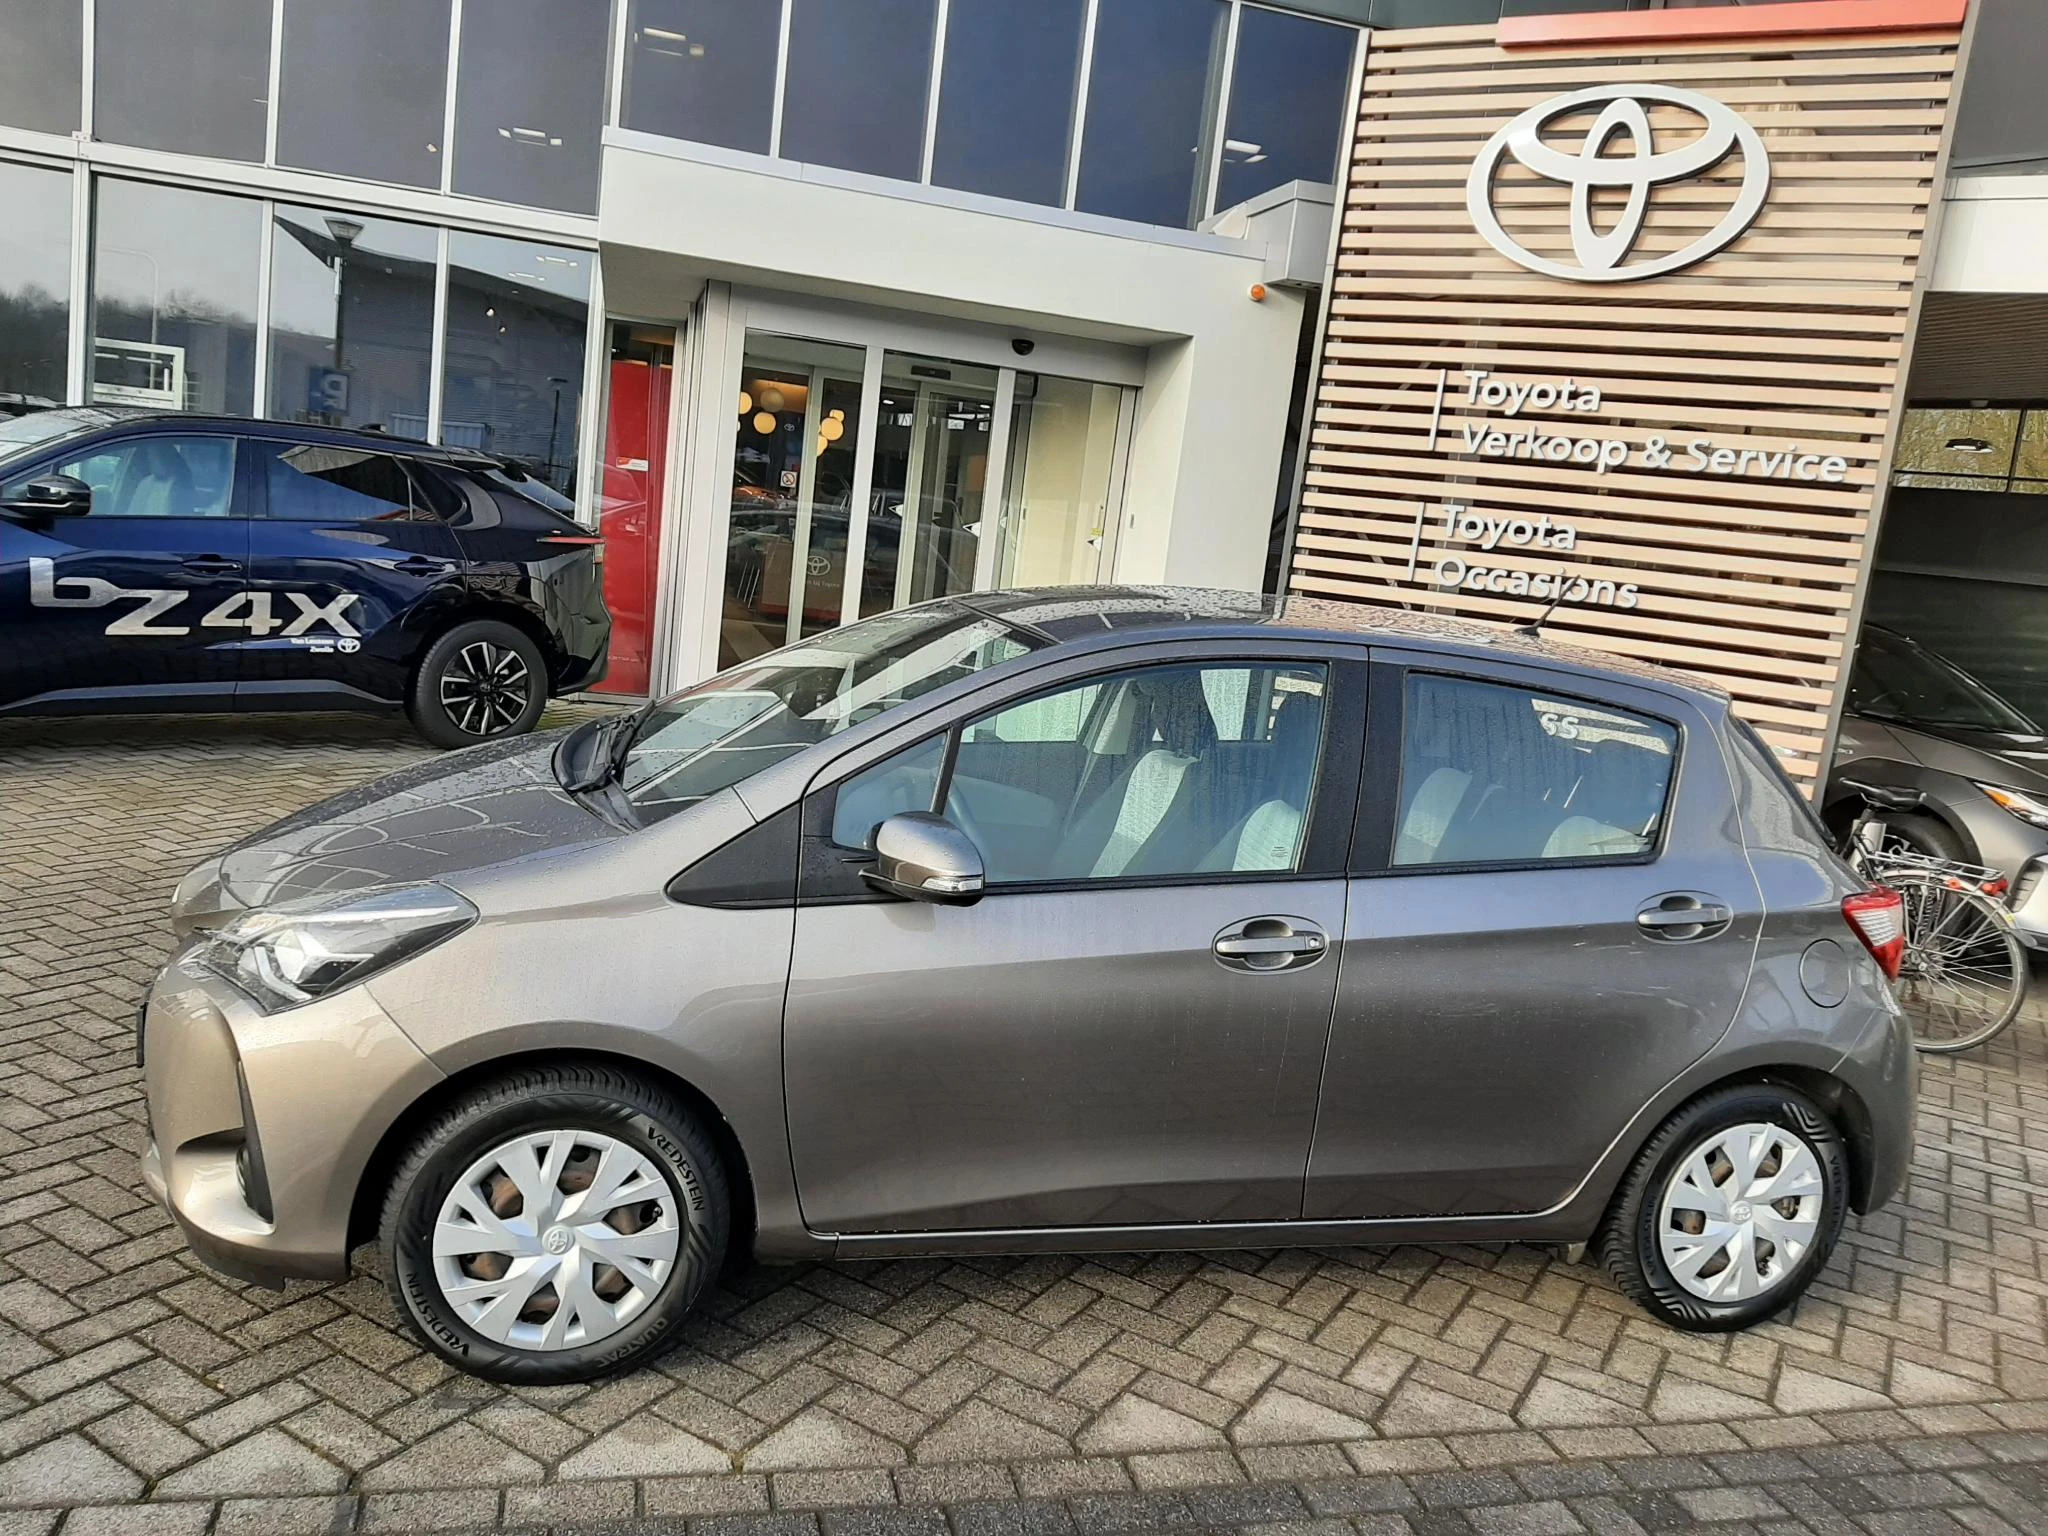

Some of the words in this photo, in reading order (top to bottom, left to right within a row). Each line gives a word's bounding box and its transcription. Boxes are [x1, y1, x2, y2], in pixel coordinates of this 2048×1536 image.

[1463, 370, 1602, 416] Toyota
[1461, 422, 1629, 474] Verkoop
[1640, 435, 1673, 470] &
[1685, 439, 1849, 483] Service
[1442, 503, 1578, 551] Toyota
[1433, 555, 1640, 609] Occasions
[648, 1126, 705, 1211] VREDESTEIN
[406, 1273, 470, 1357] VREDESTEIN
